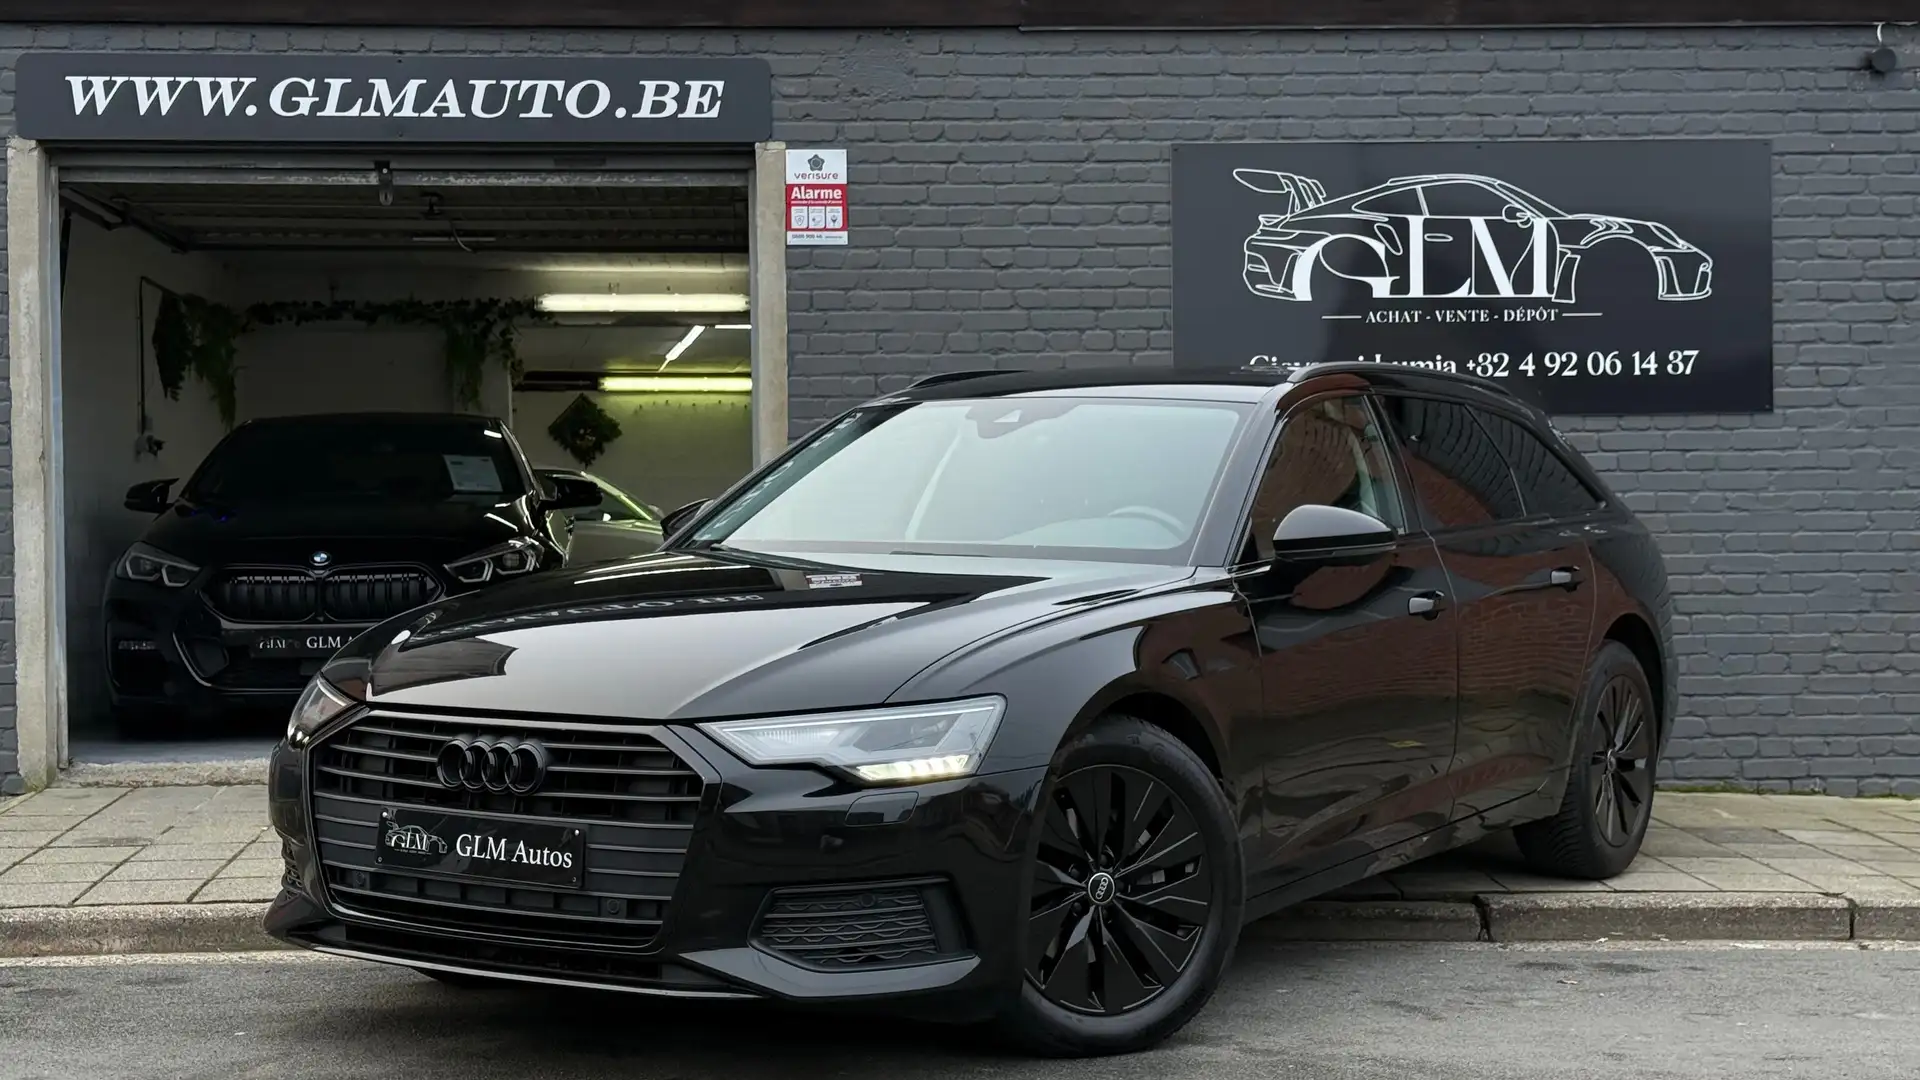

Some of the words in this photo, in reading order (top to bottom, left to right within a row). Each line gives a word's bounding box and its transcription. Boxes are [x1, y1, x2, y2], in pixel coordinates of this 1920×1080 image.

[65, 75, 725, 120] WWW.GLMAUTO.BE
[794, 172, 838, 180] verisure
[791, 186, 842, 200] Alarme
[1365, 310, 1422, 323] ACHAT
[1435, 309, 1490, 323] VENTE
[1503, 306, 1559, 322] DÉPÔT
[1466, 352, 1510, 377] +32
[1518, 352, 1536, 377] 4
[1544, 351, 1578, 377] 92
[1586, 351, 1622, 376] 06
[1631, 350, 1659, 376] 14
[1666, 349, 1700, 375] 37
[306, 635, 342, 649] GLM
[456, 833, 507, 862] GLM
[511, 839, 573, 869] Autos
